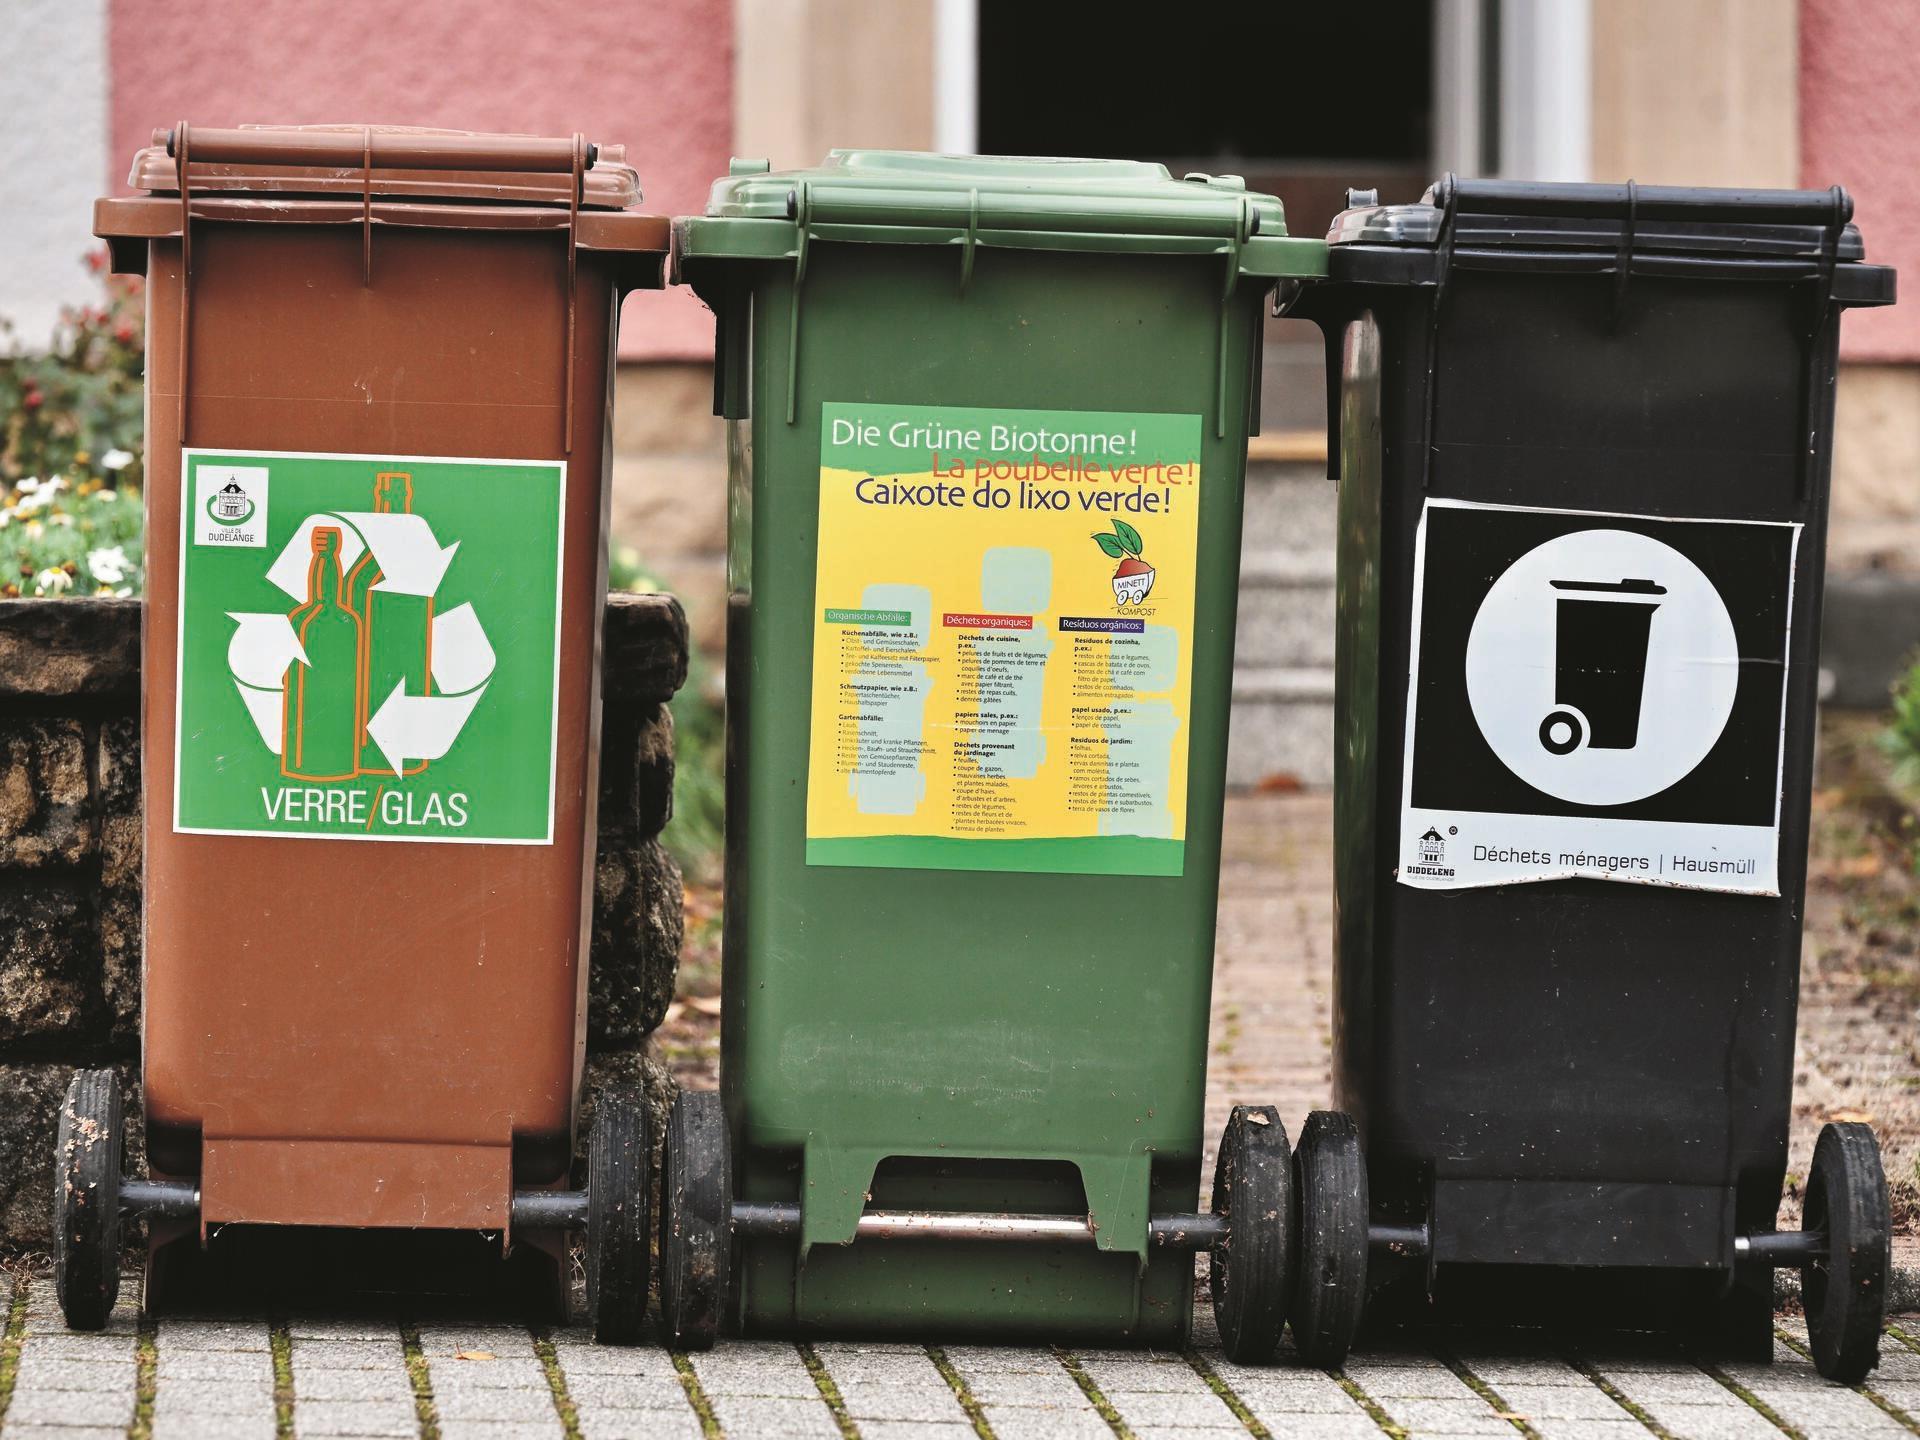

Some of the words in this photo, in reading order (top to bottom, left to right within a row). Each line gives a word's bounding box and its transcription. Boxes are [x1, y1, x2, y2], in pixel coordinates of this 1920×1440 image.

[832, 419, 881, 447] Die
[889, 421, 981, 450] Grüne
[990, 426, 1136, 455] Biotonne!
[932, 452, 965, 478] La
[975, 453, 1100, 486] poubelle
[1108, 462, 1193, 485] verte!
[855, 478, 966, 506] Caixote
[972, 481, 1011, 509] do
[1019, 483, 1070, 510] lixo
[1079, 485, 1170, 513] verde!
[209, 533, 254, 542] DUDELANGE
[1117, 579, 1145, 589] MINETT
[828, 610, 875, 621] Organische
[1117, 608, 1156, 616] KOMPOST
[946, 616, 980, 625] Déchets
[981, 618, 1030, 627] organiques:
[1063, 620, 1098, 628] Resíduos
[1100, 621, 1141, 630] orgánicos:
[261, 784, 468, 832] VERRE/GLAS
[1473, 845, 1551, 866] Déchets
[1559, 851, 1649, 871] ménagers
[1672, 855, 1755, 875] Hausmüll
[1408, 866, 1454, 876] DIDDELENG
